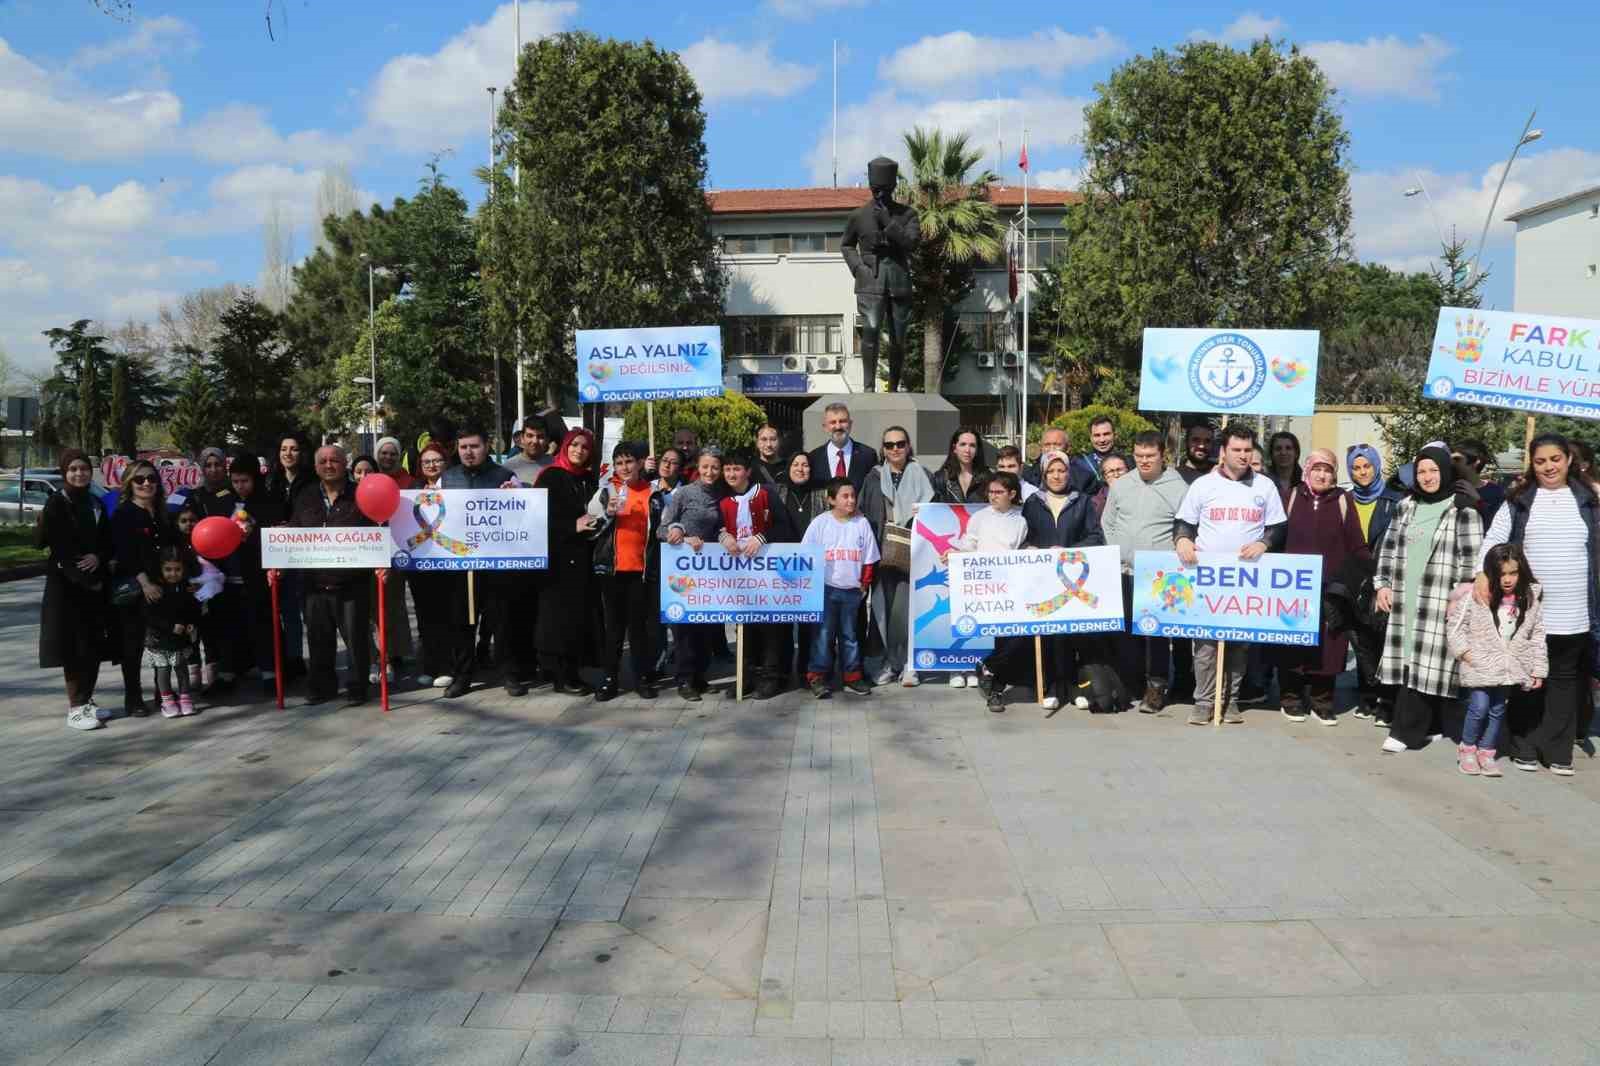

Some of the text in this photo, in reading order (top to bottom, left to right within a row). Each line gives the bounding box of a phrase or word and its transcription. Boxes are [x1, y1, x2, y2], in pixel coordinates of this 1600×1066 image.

[1508, 323, 1591, 348] FARK
[589, 342, 709, 360] ASLA YALNIZ
[1502, 347, 1589, 372] KABUL
[1463, 368, 1551, 393] BİZİMLE
[602, 387, 720, 401] GÖLCÜK OTİZM DERNEĞİ
[1455, 391, 1513, 407] GÖLCÜK
[1514, 397, 1560, 413] OTİZM
[465, 496, 526, 511] OTİZMİN
[465, 513, 502, 526] İLACI
[268, 530, 382, 544] DONANMA ÇAĞLAR
[465, 529, 529, 542] SEVGİDİR
[416, 556, 545, 570] GÖLCÜK OTİZM DERNEĞİ
[675, 552, 813, 571] GÜLÜMSEYİN
[962, 553, 1053, 568] FARKLILIKLAR
[963, 567, 992, 580] BİZE
[1196, 566, 1313, 590] BEN DE
[963, 582, 1009, 596] RENK
[772, 594, 802, 606] VAR
[963, 599, 1015, 614] KATAR
[1204, 594, 1309, 619] VARIM!
[688, 611, 820, 623] GÖLCÜK OTİZM DERNEĞİ
[980, 618, 1121, 636] GÖLCÜK OTİZM DERNEĞİ
[1162, 624, 1315, 645] GÖLCÜK OTİZM DERNEĞİ
[939, 652, 983, 664] GÖLCÜK
